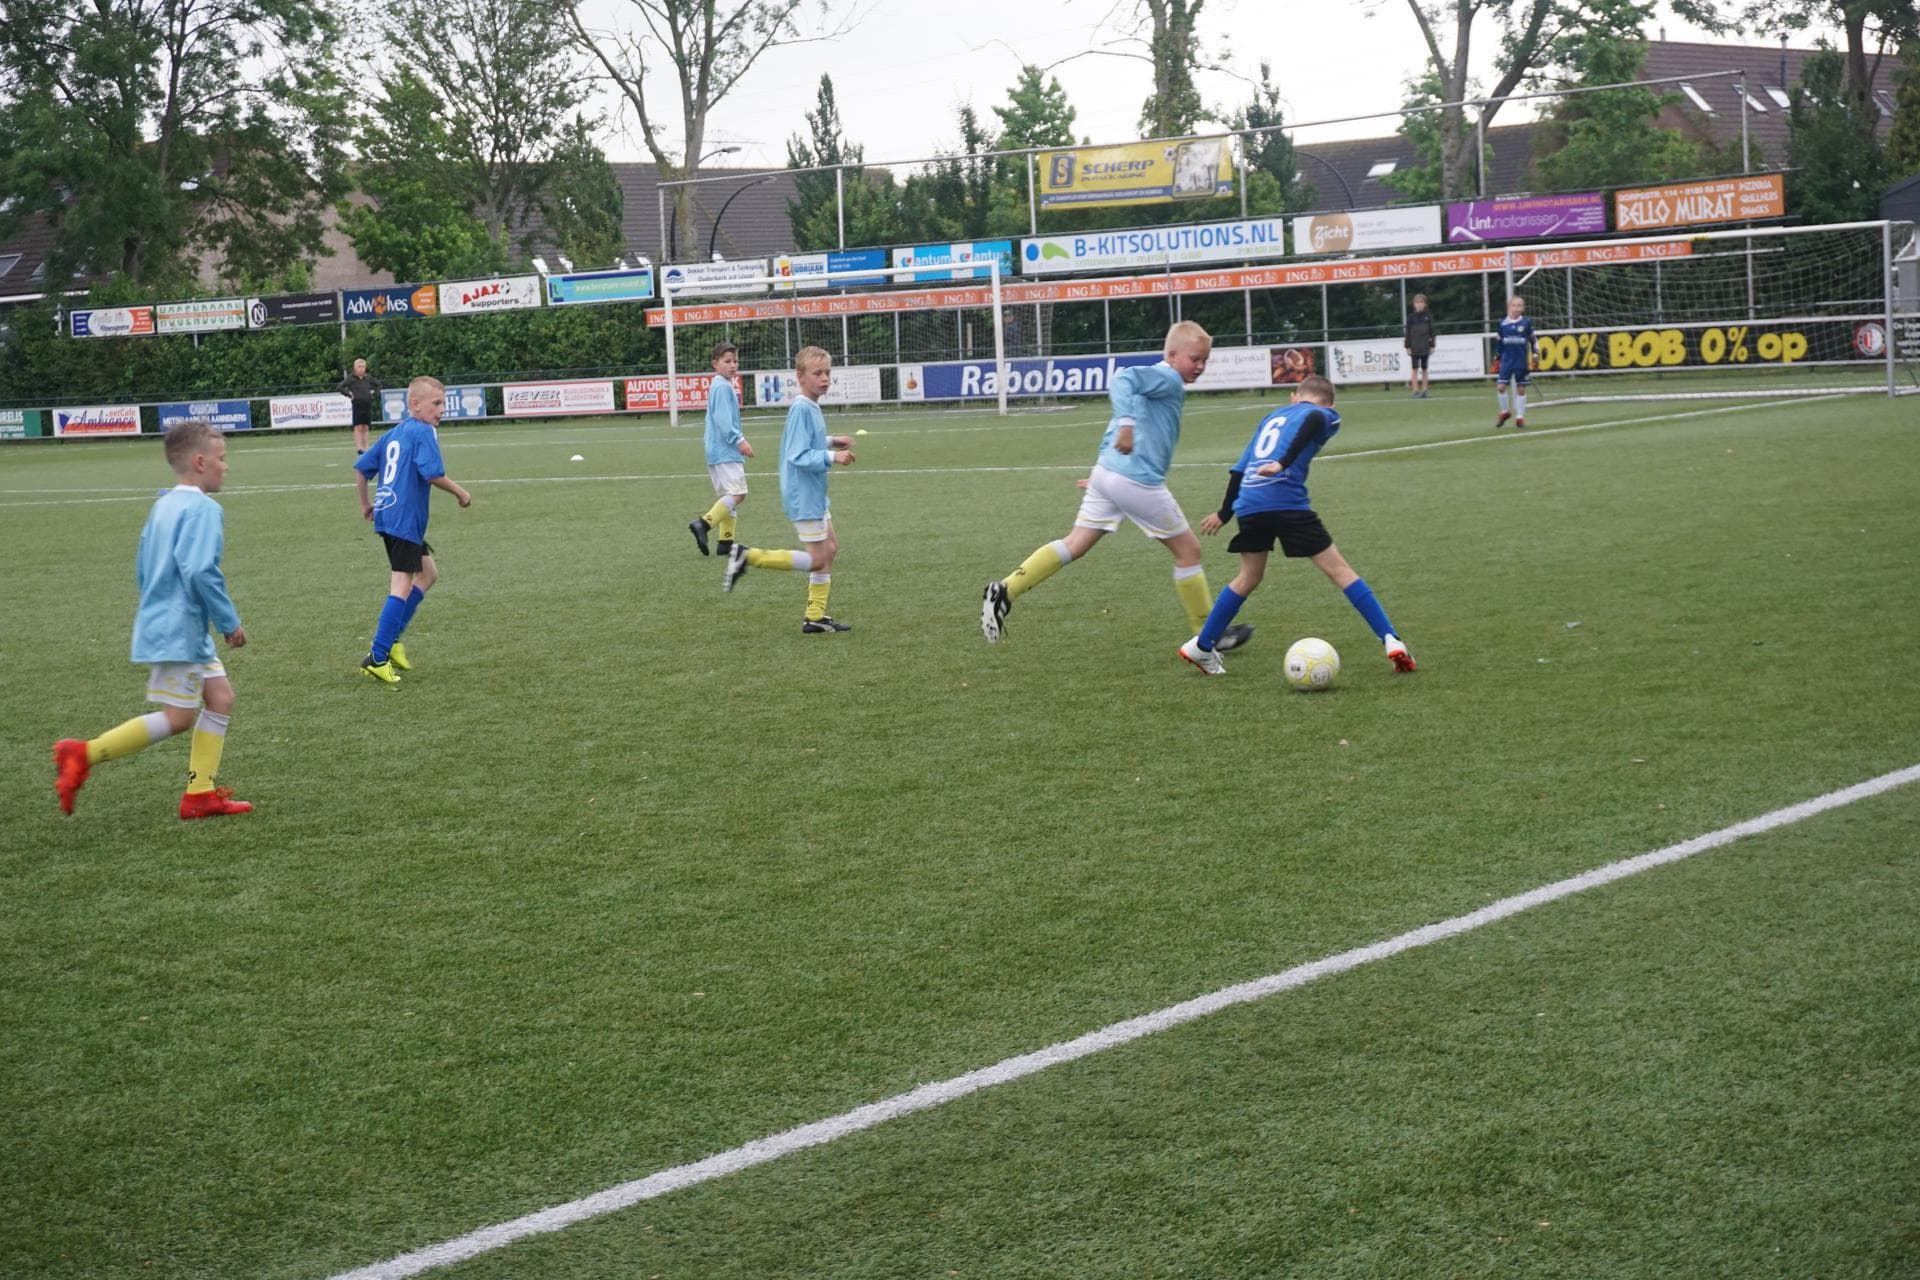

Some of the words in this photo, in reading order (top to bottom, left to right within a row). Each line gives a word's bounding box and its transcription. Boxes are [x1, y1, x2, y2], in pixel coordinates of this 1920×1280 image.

[1081, 159, 1154, 175] SCHERP
[1619, 200, 1670, 227] BELLO
[1675, 193, 1735, 223] MURAT
[1074, 223, 1279, 257] B-KITSOLUTIONS.NL
[463, 283, 500, 305] AJAX
[684, 310, 702, 321] ING
[719, 308, 737, 319] ING
[792, 304, 810, 314] ING
[829, 302, 848, 311] ING
[867, 299, 886, 309] ING
[905, 296, 925, 306] ING
[944, 294, 964, 304] ING
[1025, 289, 1046, 300] ING
[1067, 286, 1088, 297] ING
[1109, 284, 1130, 294] ING
[1195, 278, 1217, 289] ING
[1240, 274, 1263, 285] ING
[1286, 271, 1309, 282] ING
[1333, 267, 1357, 279] ING
[1382, 263, 1407, 275] ING
[1432, 260, 1457, 271] ING
[1587, 248, 1613, 260] ING
[1640, 245, 1666, 257] ING
[471, 297, 519, 308] supporters
[1528, 332, 1600, 371] 00%
[1608, 330, 1686, 368] BOB
[1701, 327, 1749, 363] 0%
[1757, 331, 1808, 363] op
[627, 377, 699, 393] AUTOBERIJF
[73, 410, 136, 427] Ambiance
[272, 400, 322, 416] RODENBURG
[1254, 416, 1288, 459] 6
[383, 440, 400, 485] 8
